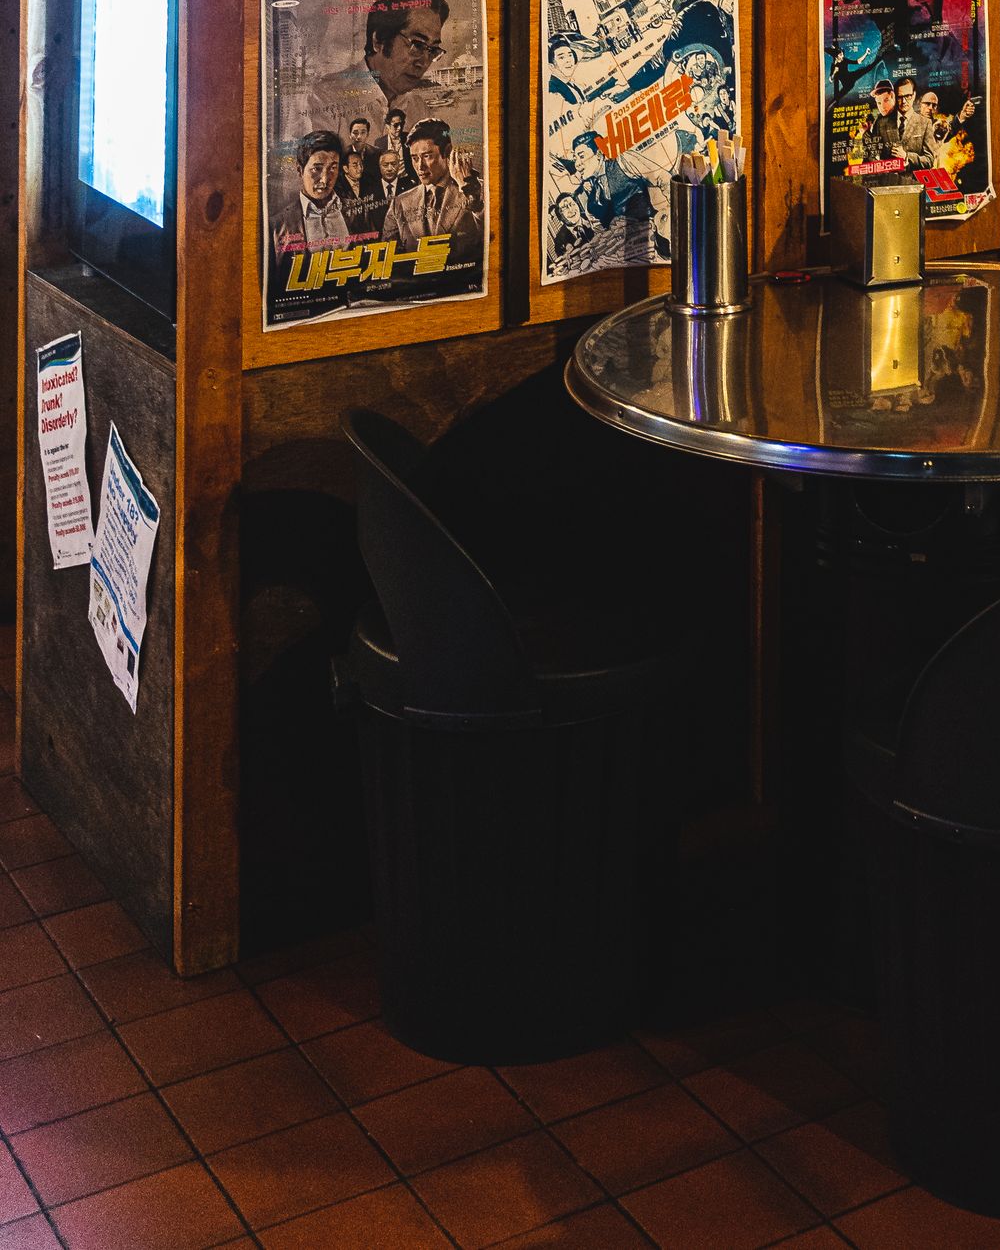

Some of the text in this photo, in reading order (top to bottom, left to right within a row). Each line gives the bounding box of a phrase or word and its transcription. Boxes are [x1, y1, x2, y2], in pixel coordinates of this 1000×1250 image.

[594, 73, 695, 159] 베테랑
[613, 103, 630, 119] 2015
[850, 160, 902, 175] 특급비밀요원
[41, 366, 79, 394] Intoxicated?
[41, 392, 64, 415] Drunk?
[41, 408, 78, 434] Disorderly?
